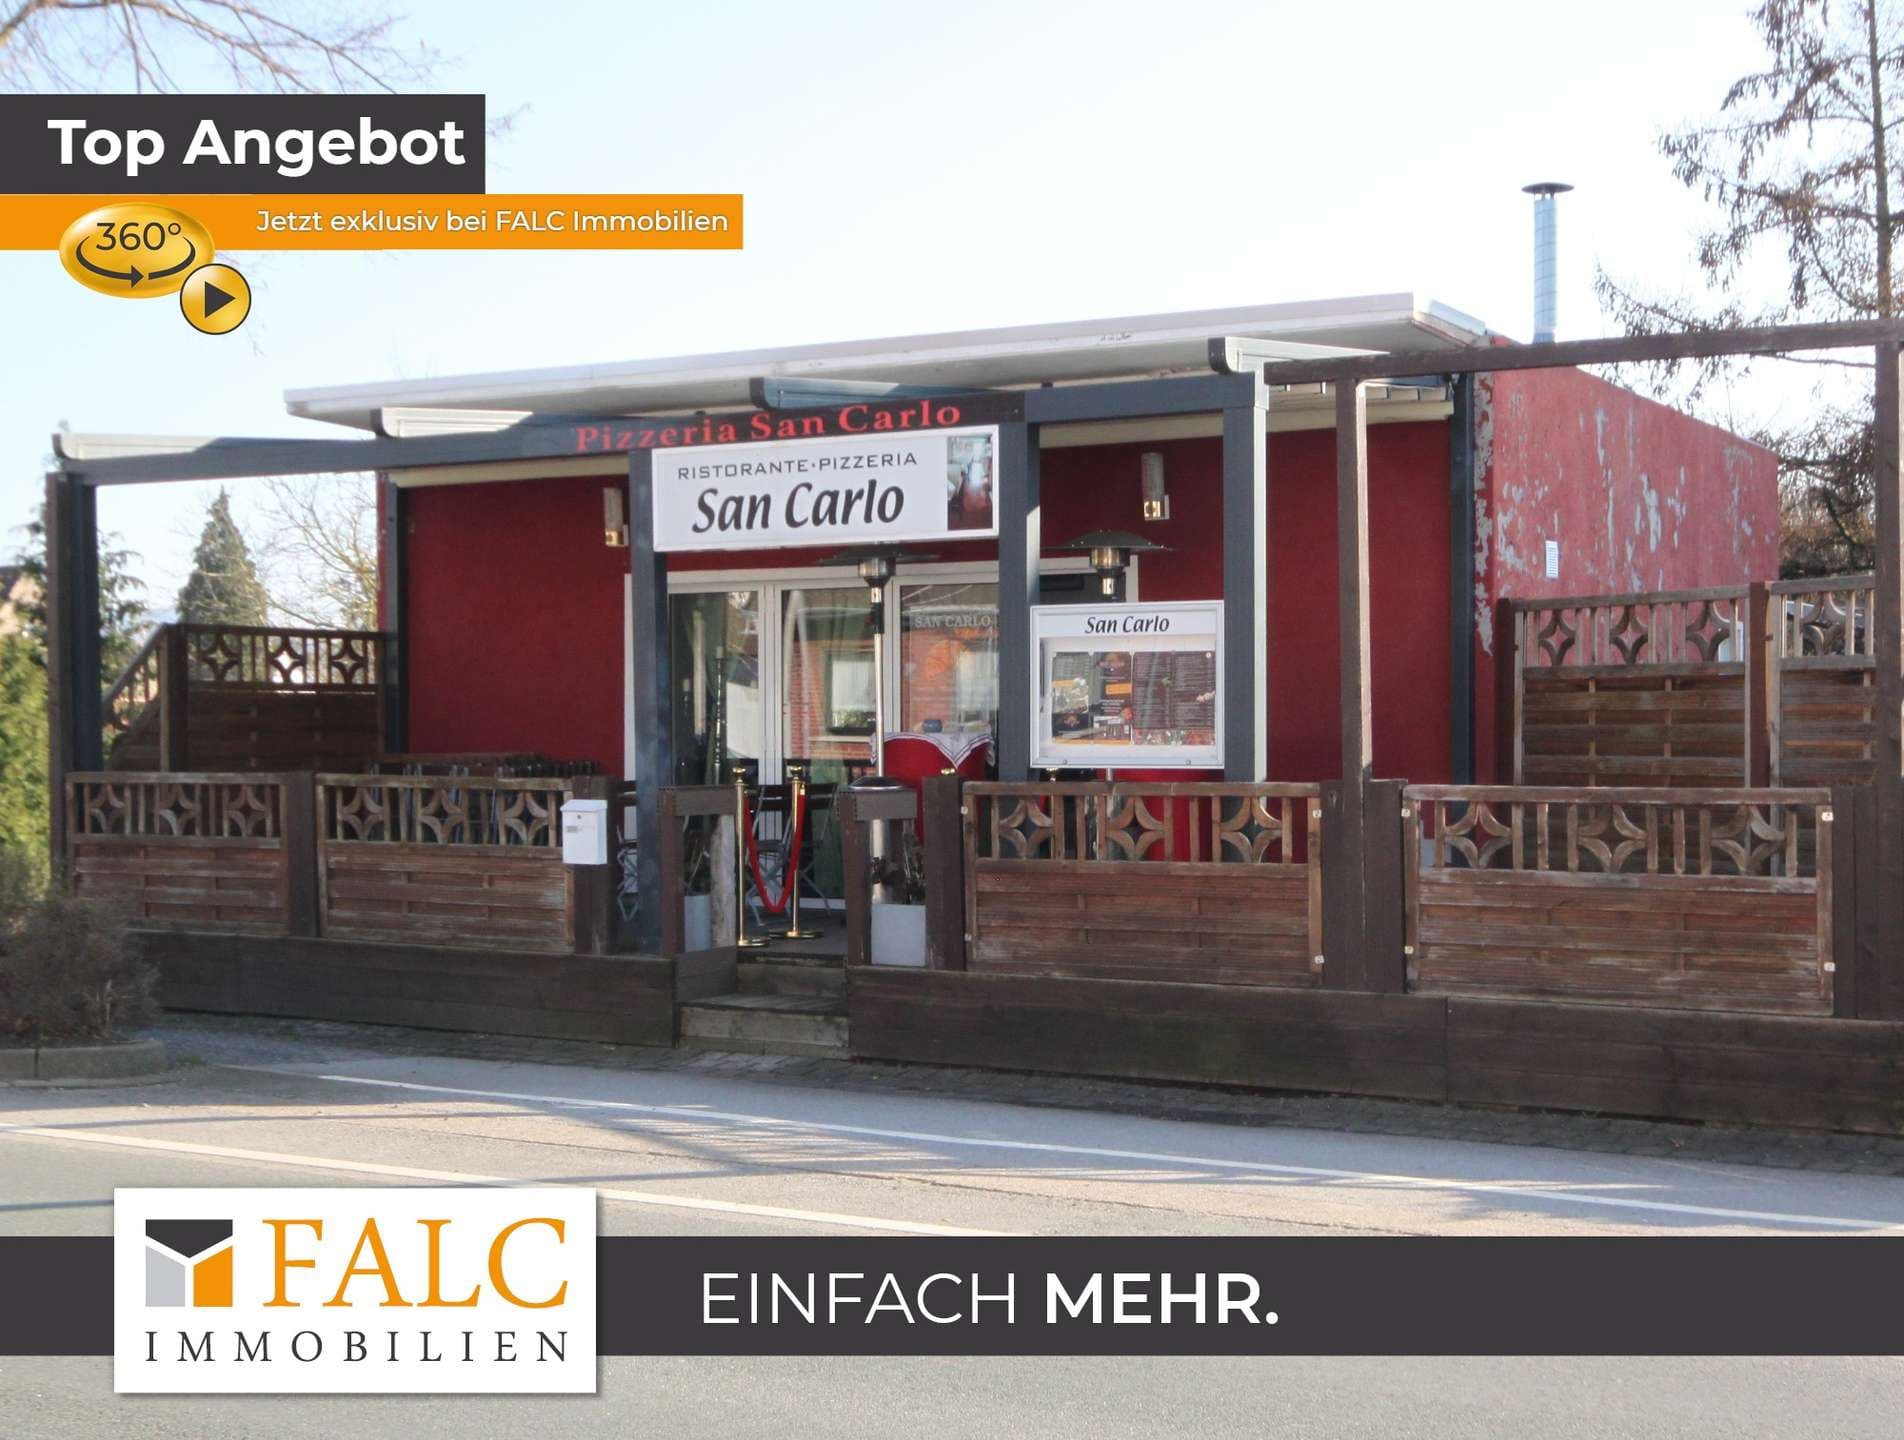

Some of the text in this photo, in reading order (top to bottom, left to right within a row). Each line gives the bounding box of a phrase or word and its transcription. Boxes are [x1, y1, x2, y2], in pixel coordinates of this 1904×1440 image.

[576, 400, 961, 451] Pizzeria San Carlo
[692, 479, 905, 533] San Carlo
[945, 615, 991, 628] CARLO
[1085, 615, 1170, 634] San Carlo
